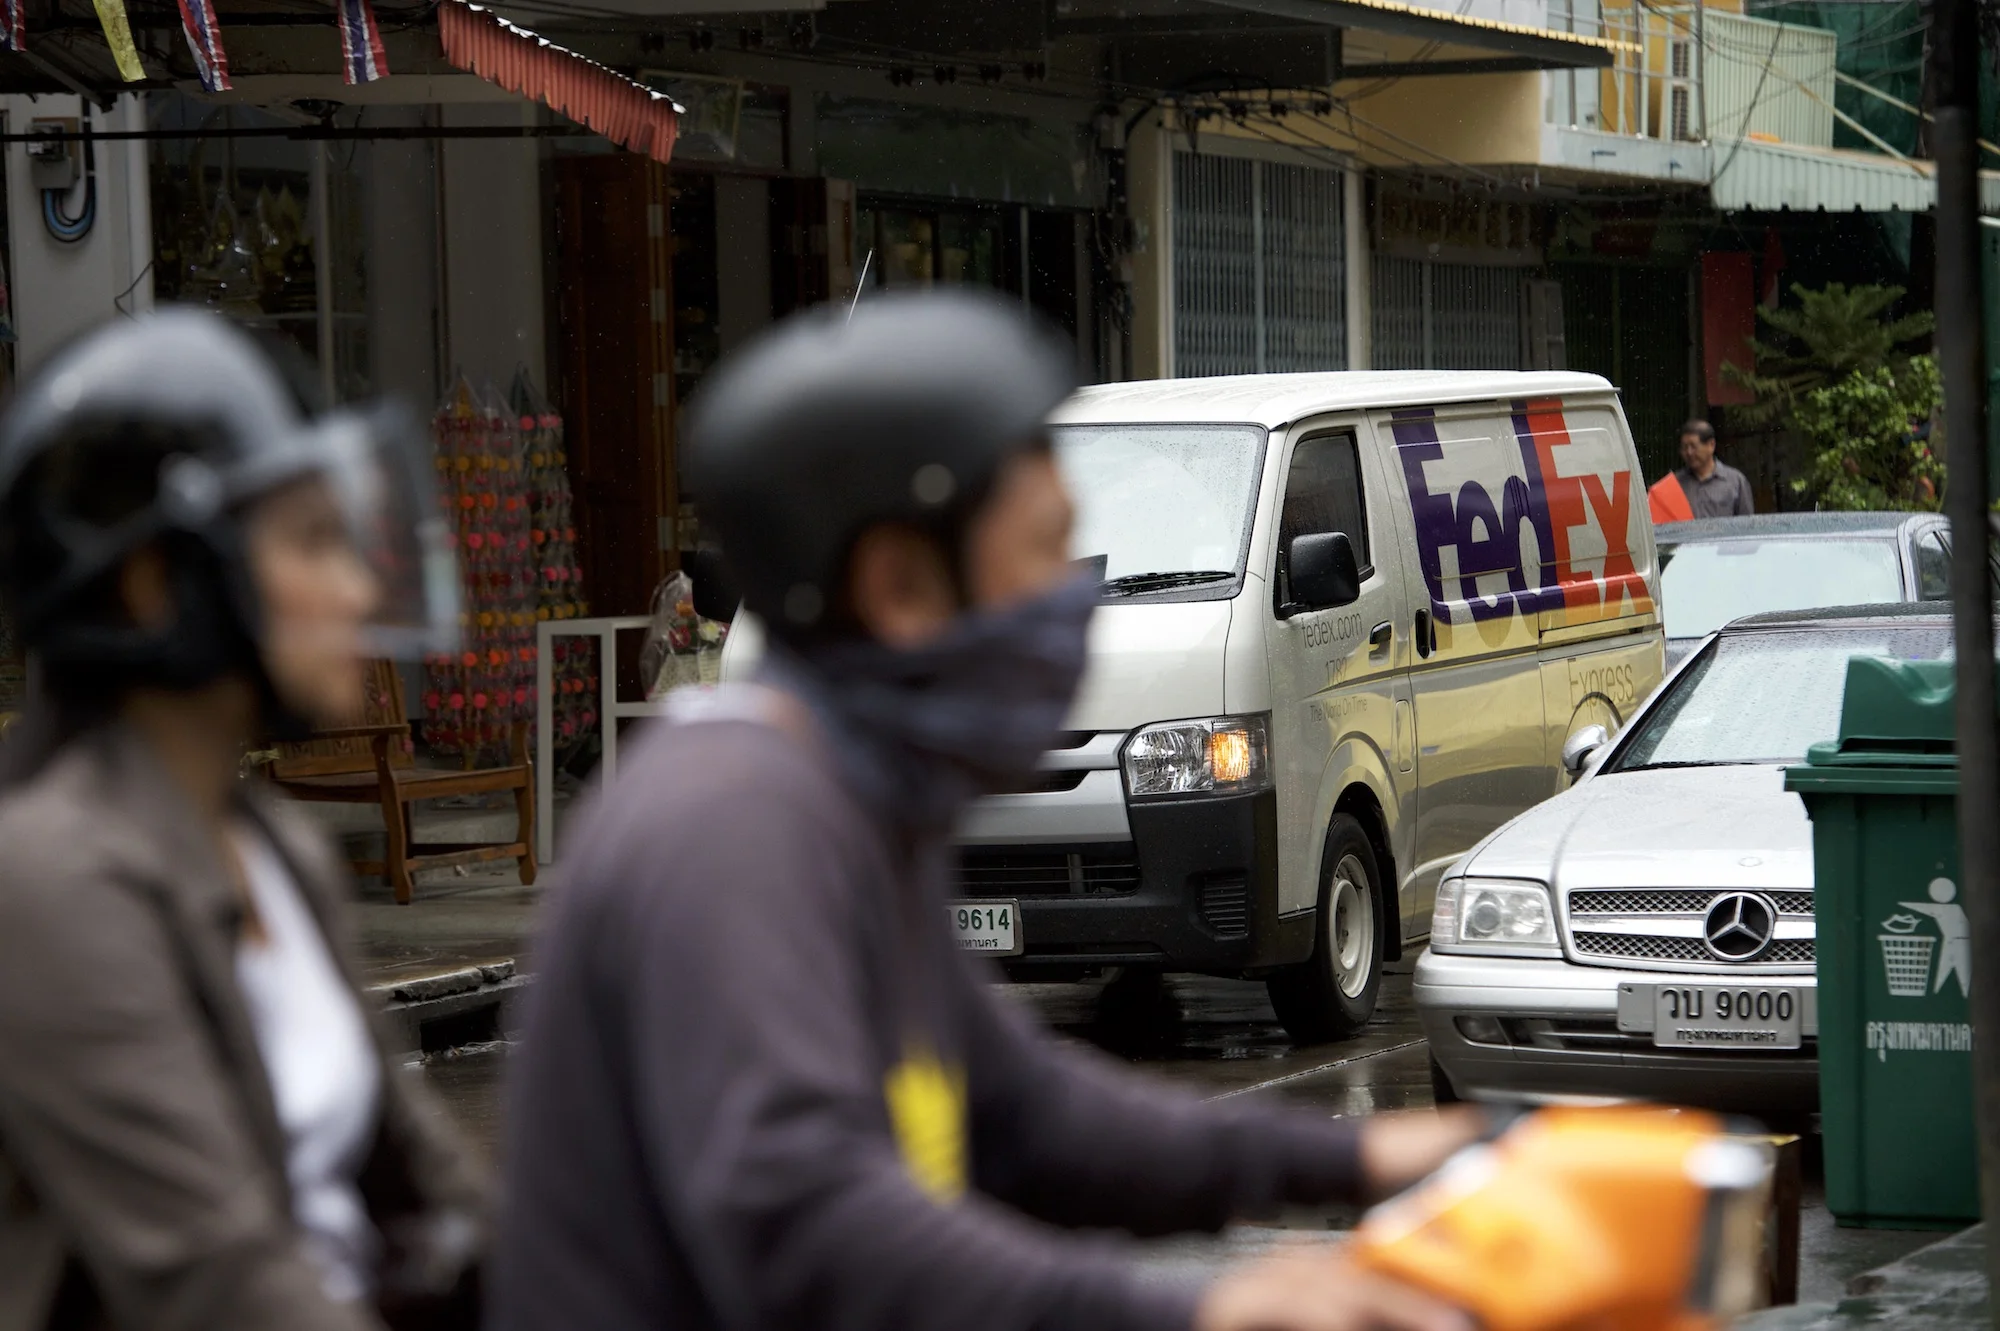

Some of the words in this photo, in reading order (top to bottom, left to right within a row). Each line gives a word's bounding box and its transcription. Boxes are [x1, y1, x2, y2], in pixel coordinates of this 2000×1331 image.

[1391, 395, 1656, 652] FedEx
[1301, 613, 1363, 649] fedex.com
[1567, 657, 1634, 721] Express
[1310, 705, 1323, 722] The
[1322, 699, 1341, 720] World
[1343, 698, 1352, 716] On
[1352, 696, 1367, 712] Time
[957, 908, 1010, 930] 9614
[1661, 987, 1704, 1020] วบ
[1714, 988, 1794, 1021] 9000
[1676, 1027, 1778, 1044] กรุงเทพมหานคร
[1866, 1020, 1975, 1062] กรุงเทพมหานค
